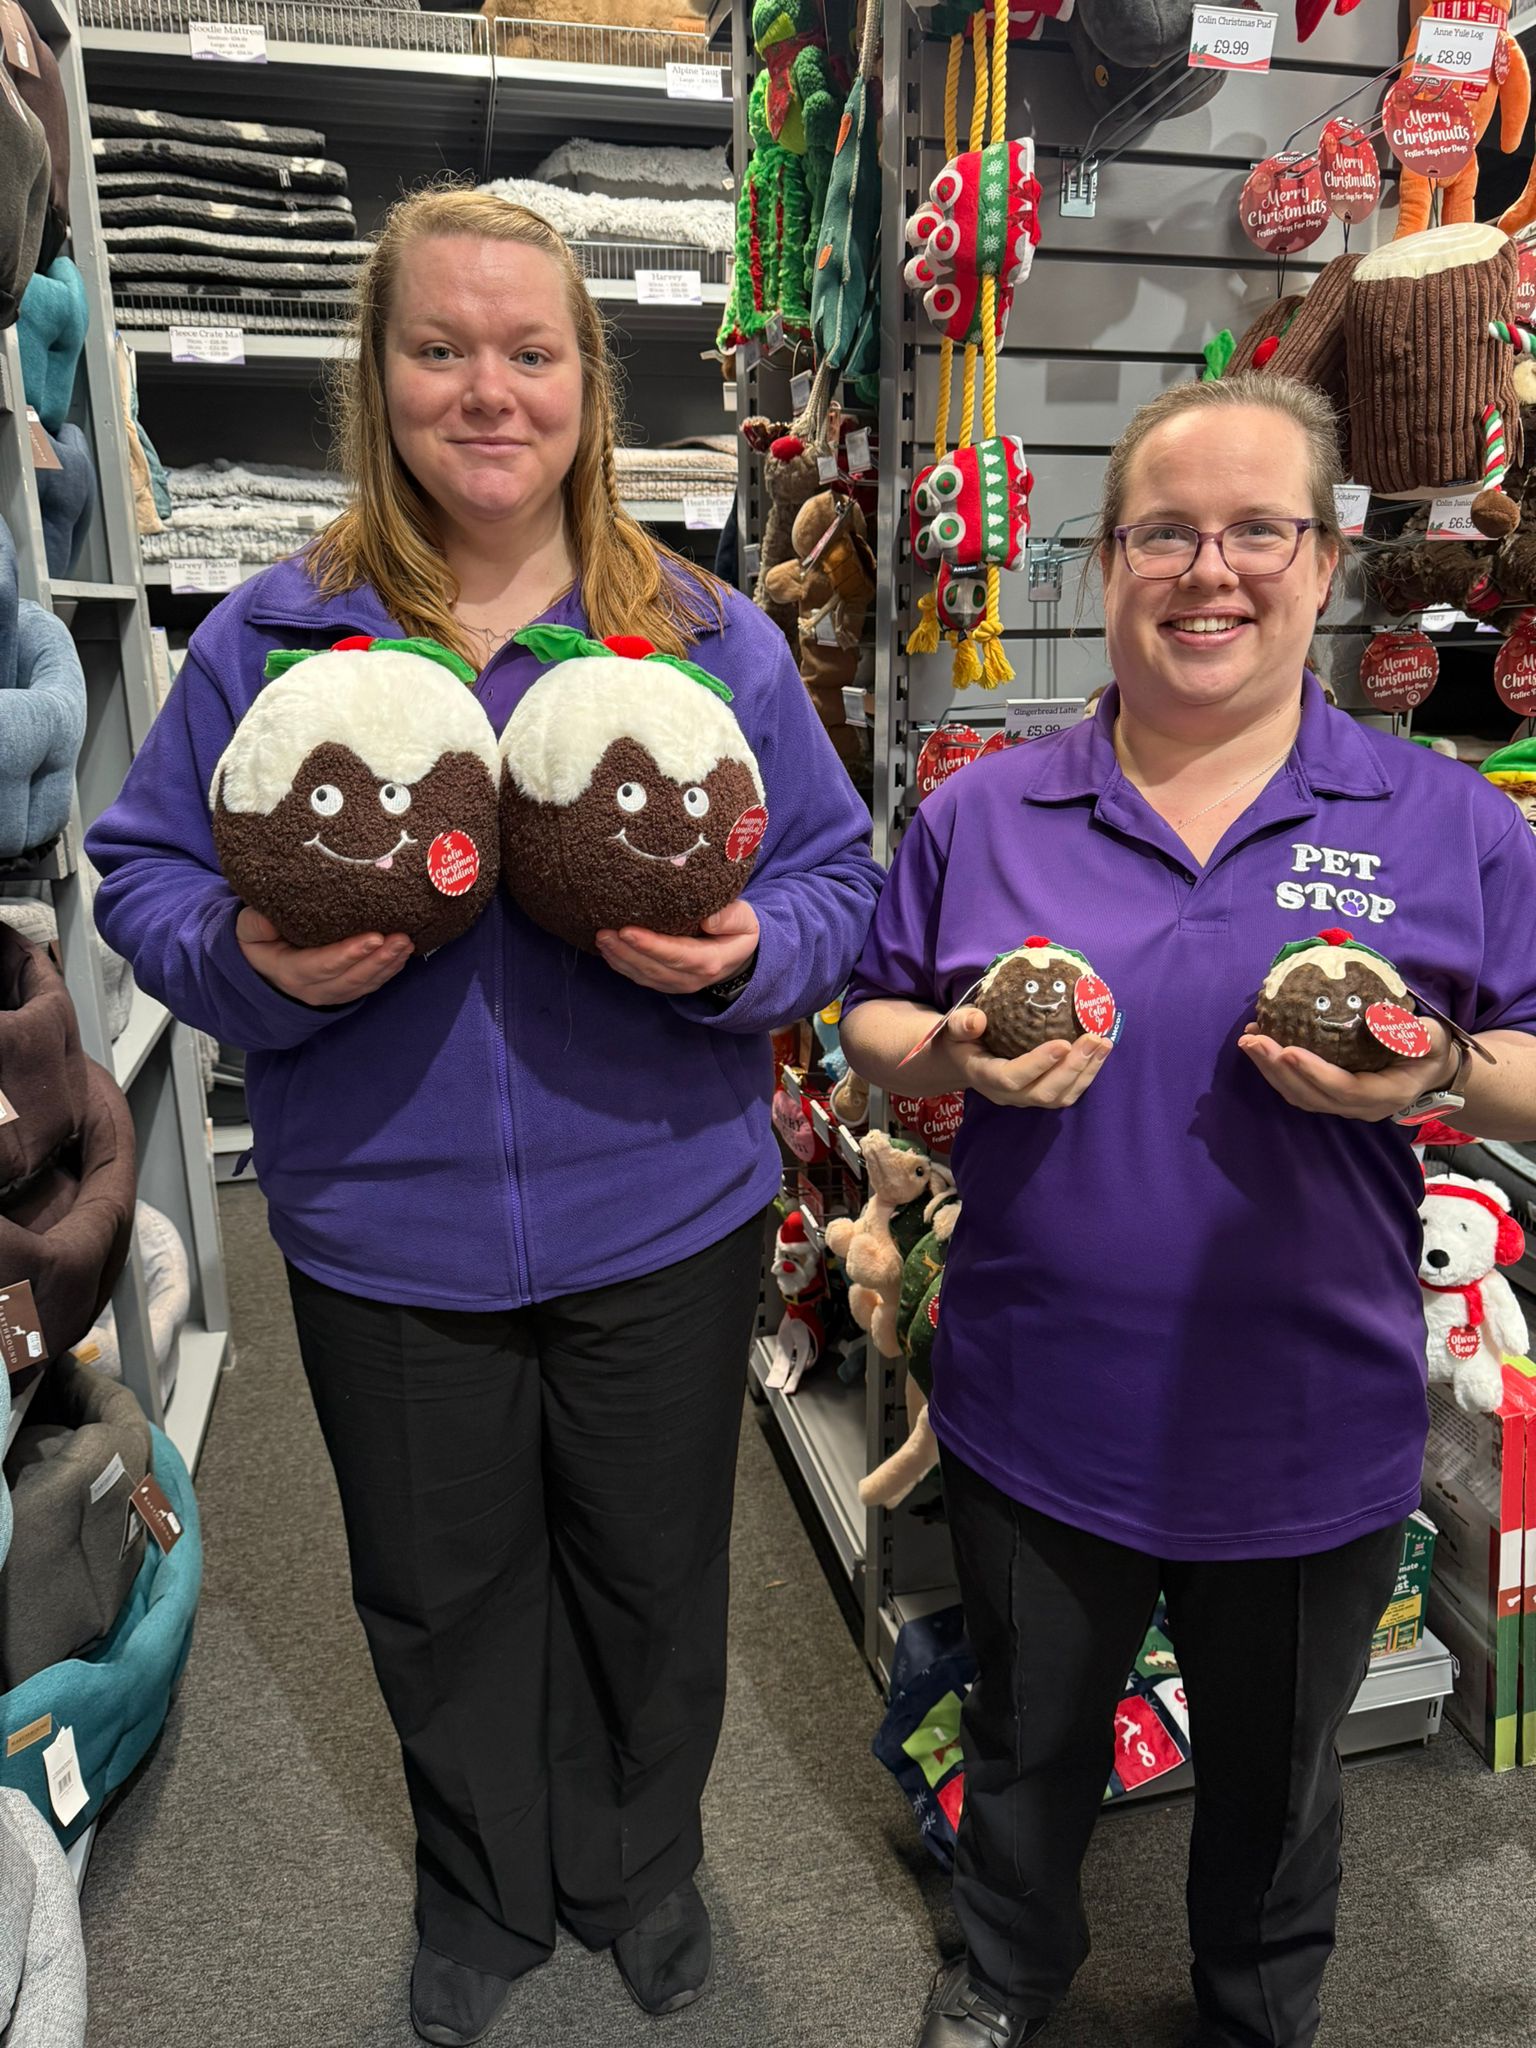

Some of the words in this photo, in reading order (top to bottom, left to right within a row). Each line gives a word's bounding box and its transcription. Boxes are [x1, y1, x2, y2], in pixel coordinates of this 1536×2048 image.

[1197, 15, 1216, 25] Colin
[1218, 16, 1255, 27] Christmas
[1256, 20, 1271, 29] Pud
[1433, 27, 1453, 37] Anne
[1454, 28, 1470, 38] Yule
[1471, 30, 1484, 40] Log
[1213, 40, 1250, 55] £9.99
[1437, 50, 1472, 65] £8.99
[672, 66, 699, 76] Alpine
[700, 68, 721, 77] Taup
[1405, 109, 1451, 128] Merry
[1393, 124, 1470, 145] Christmutts
[1404, 148, 1425, 158] Festive
[1425, 147, 1440, 157] Toys
[1440, 145, 1451, 154] For
[1451, 144, 1468, 154] Dogs
[1332, 152, 1364, 174] Merry
[1324, 171, 1376, 189] Christmutts
[1261, 187, 1309, 209] Merry
[1247, 199, 1327, 227] Christmutts
[1257, 228, 1277, 238] Festive
[1278, 225, 1293, 234] Toys
[1294, 222, 1305, 230] For
[1305, 218, 1322, 227] Dogs
[651, 273, 682, 281] Harvey
[200, 330, 223, 338] Crate
[1454, 499, 1472, 507] Junio
[1448, 516, 1476, 529] £6.9
[1378, 656, 1418, 674] Merry
[1367, 666, 1433, 689] Christmutts
[1014, 707, 1058, 716] Gingerbread
[1059, 706, 1078, 714] Latte
[933, 755, 971, 775] Merry
[441, 849, 463, 865] Colin
[1291, 844, 1381, 880] PET
[435, 853, 475, 879] Christmas
[441, 865, 475, 887] Pudding
[1276, 881, 1396, 923] STOP
[1079, 993, 1111, 1010] Bouncing
[1088, 1005, 1107, 1018] Colin
[1095, 1016, 1104, 1029] Jr
[1373, 1020, 1422, 1032] Bouncing
[1389, 1030, 1417, 1040] Colin
[1402, 1039, 1415, 1050] Jr
[934, 1102, 964, 1119] Mer
[1451, 1335, 1477, 1345] Olwen
[1455, 1344, 1475, 1353] Bear
[932, 1727, 947, 1741] 1
[1137, 1741, 1156, 1767] 8
